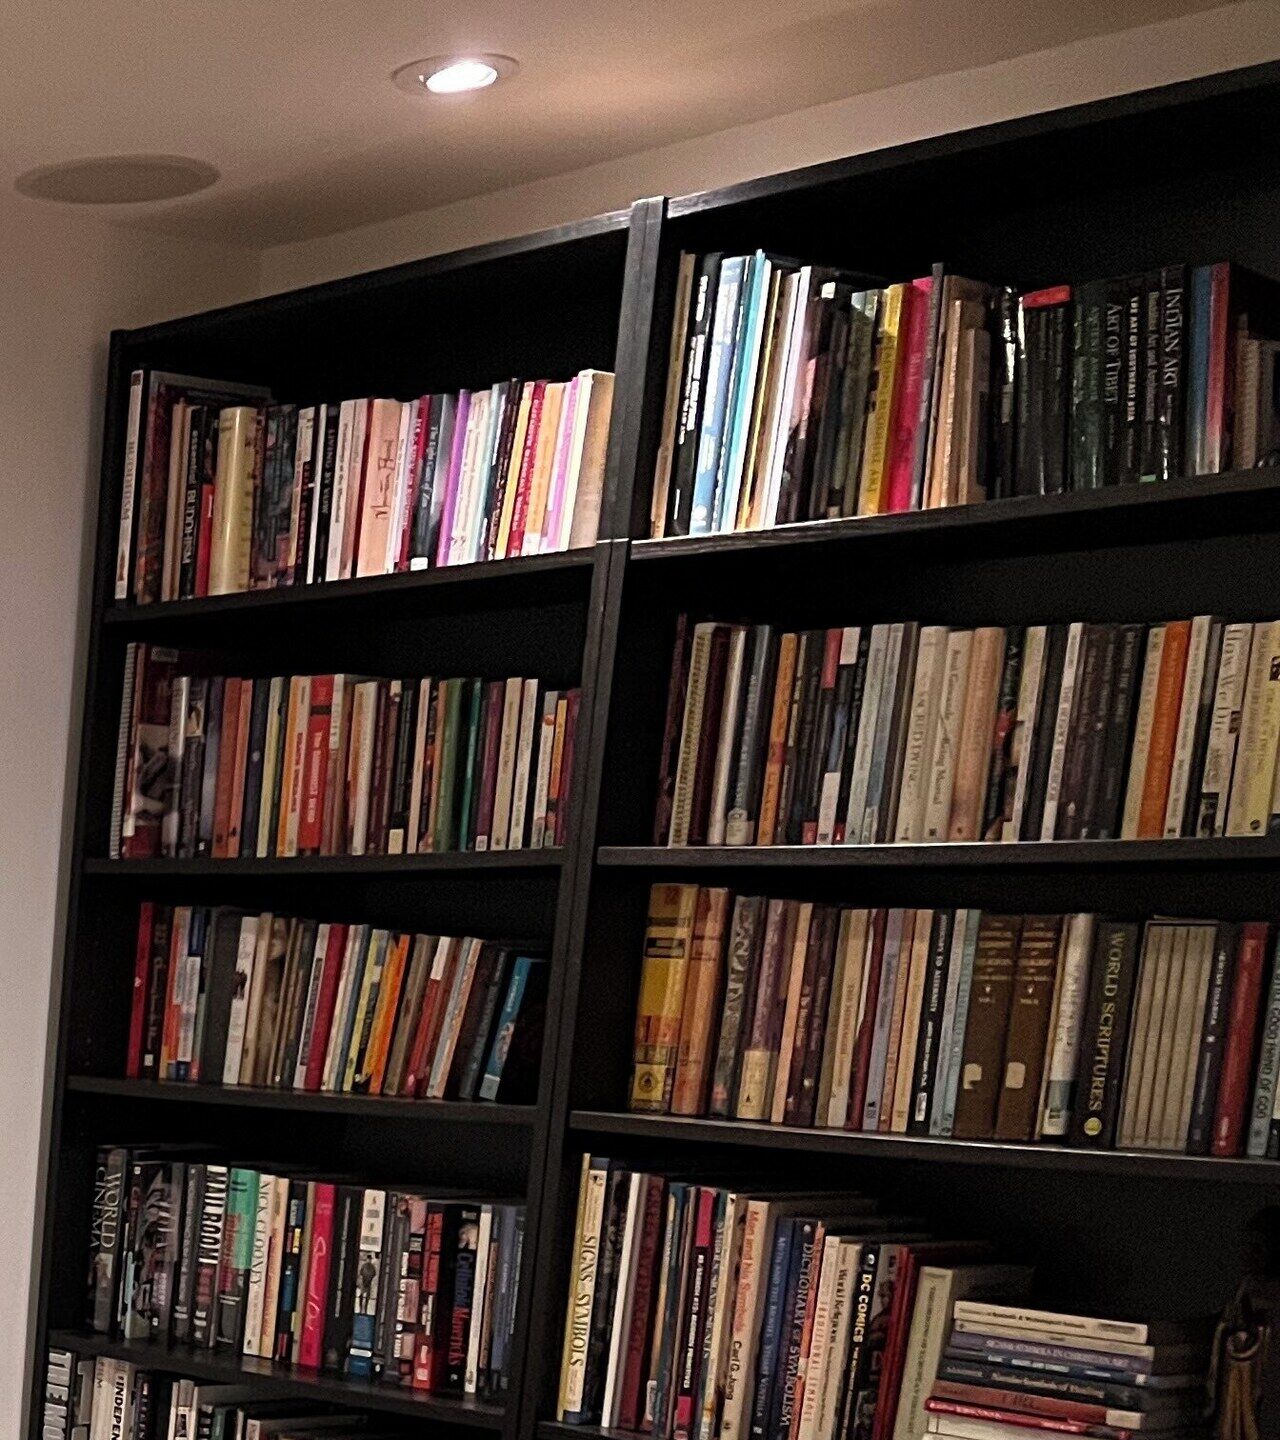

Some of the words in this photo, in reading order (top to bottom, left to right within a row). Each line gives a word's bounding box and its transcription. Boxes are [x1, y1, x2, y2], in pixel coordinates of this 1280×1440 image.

[1106, 303, 1123, 331] ART
[1163, 287, 1183, 351] INDIAN
[1162, 356, 1180, 386] ART
[182, 489, 197, 564] BUDDHISM
[1223, 629, 1241, 667] How
[1218, 673, 1235, 697] We
[1214, 706, 1231, 737] Die
[1104, 931, 1127, 997] WORLD
[1089, 1002, 1115, 1111] SCRIPTURES
[90, 1166, 108, 1248] CINEMA
[100, 1172, 122, 1249] WORLD
[198, 1171, 227, 1264] MAILROOM
[258, 1181, 271, 1213] NICK
[249, 1220, 267, 1286] CLOONEY
[579, 1236, 597, 1282] SIGNS
[793, 1243, 815, 1330] DICTIONARY
[860, 1273, 873, 1291] DC
[448, 1307, 470, 1366] Mavericks
[568, 1294, 590, 1366] SYMBOLS
[853, 1295, 869, 1343] COMICS
[46, 1351, 72, 1401] THE
[732, 1341, 743, 1361] Carl
[724, 1374, 739, 1400] Jung
[780, 1346, 801, 1426] SYMBOLISM
